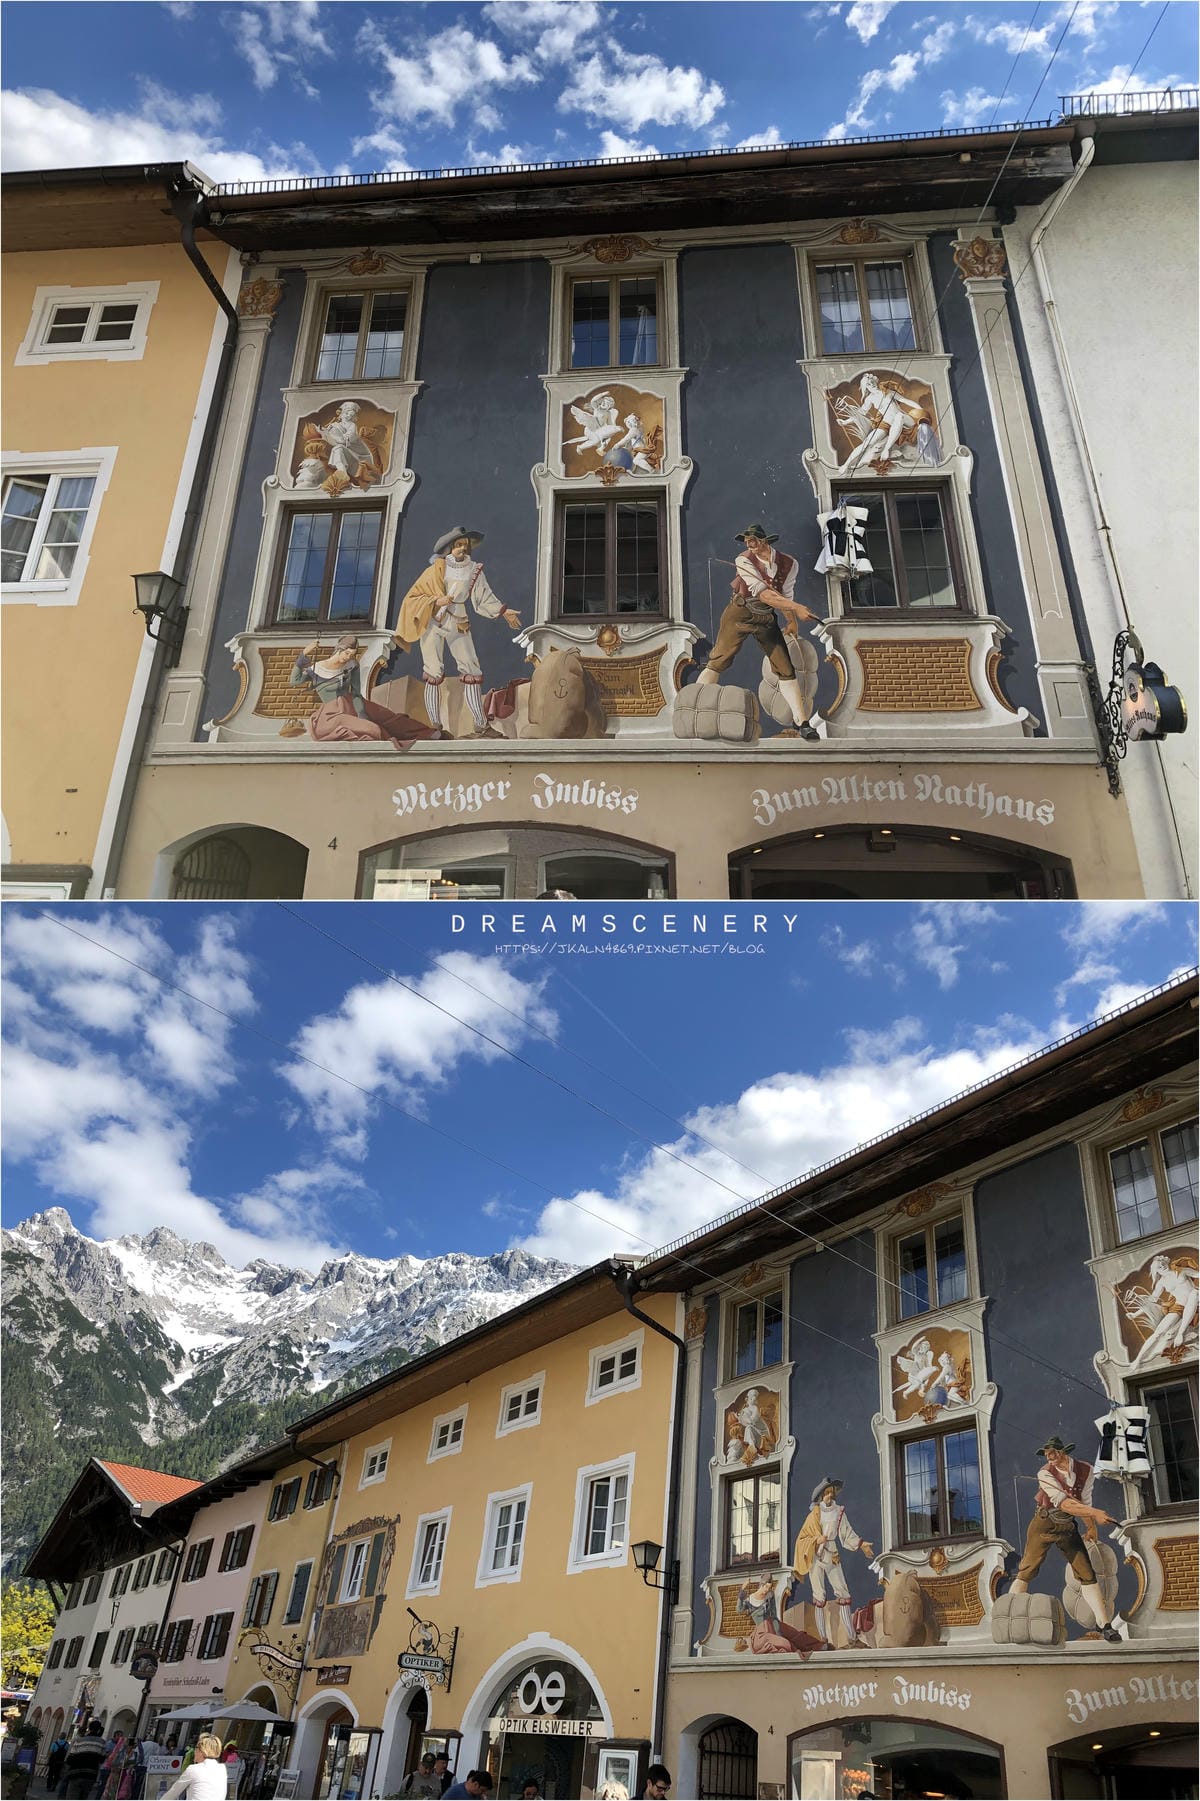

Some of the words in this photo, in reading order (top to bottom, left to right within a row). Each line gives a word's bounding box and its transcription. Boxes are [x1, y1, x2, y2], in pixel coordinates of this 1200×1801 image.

[392, 780, 511, 816] Metzger
[531, 773, 639, 815] Imbiss
[752, 785, 821, 826] Zum
[821, 775, 908, 804] Alten
[913, 773, 1056, 826] Rathaus
[328, 836, 338, 850] 4
[404, 1656, 440, 1668] OPTIKER
[802, 1681, 878, 1710] Metzger
[892, 1675, 972, 1711] Imbiss
[1064, 1688, 1128, 1724] Zum
[1129, 1674, 1199, 1704] Alte
[499, 1719, 528, 1733] OPTIK
[532, 1720, 593, 1736] ELSWEILER
[767, 1725, 775, 1735] 4
[149, 1763, 170, 1771] POINT
